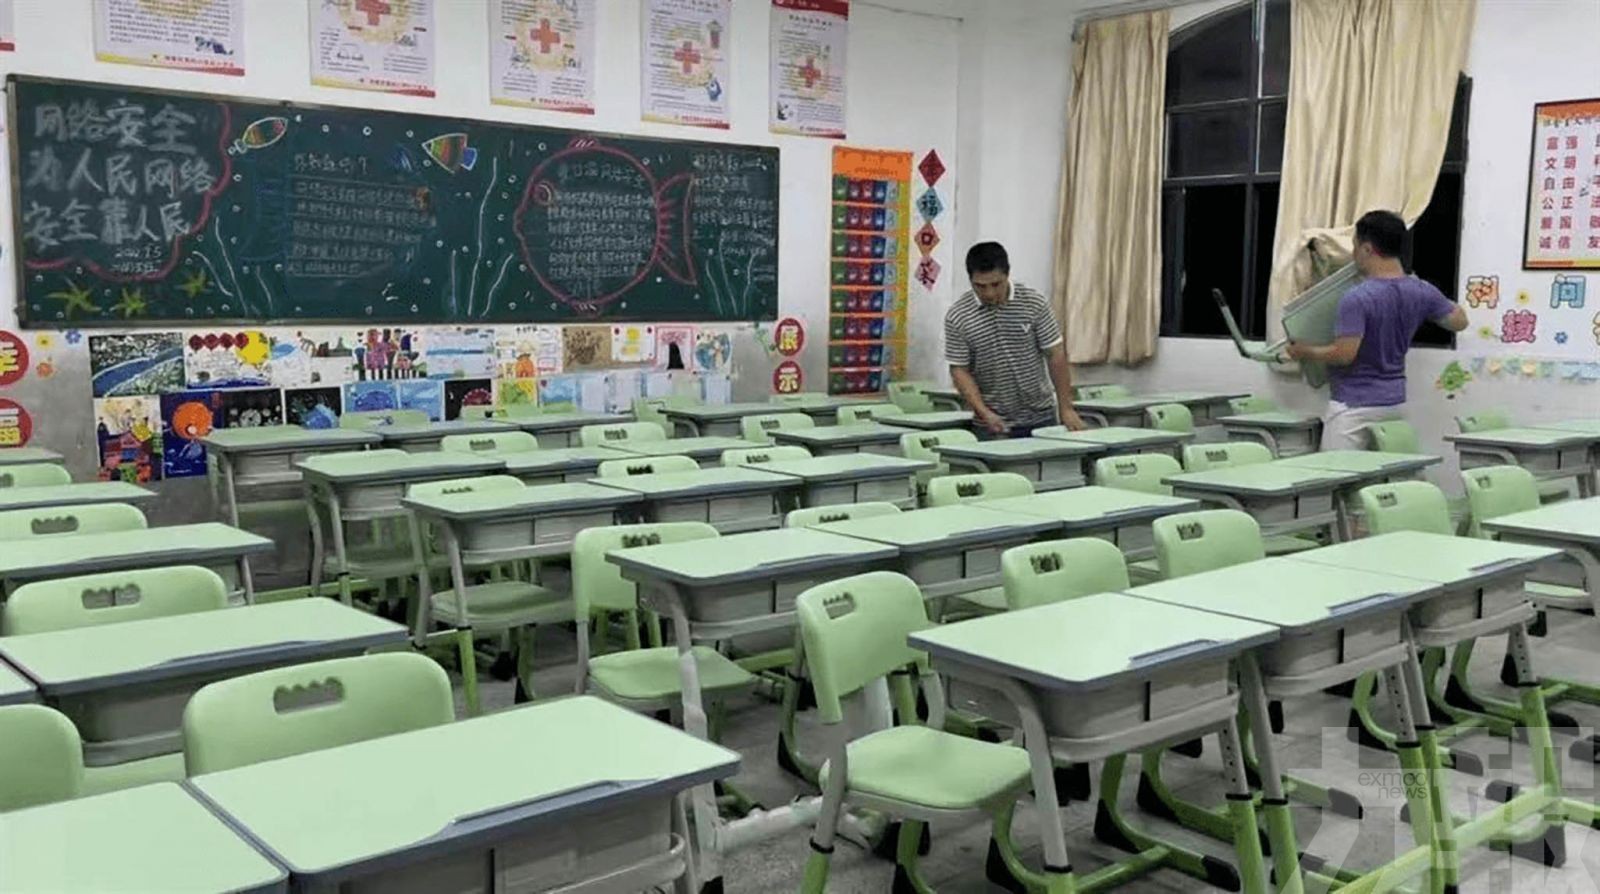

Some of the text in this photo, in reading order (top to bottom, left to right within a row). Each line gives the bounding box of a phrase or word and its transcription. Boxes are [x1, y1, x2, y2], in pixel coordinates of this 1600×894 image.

[35, 99, 197, 154] 网络安全
[26, 146, 216, 197] 为人民网络
[1544, 177, 1575, 190] 自由
[23, 198, 193, 250] 安全靠人民
[1542, 196, 1573, 210] 公正
